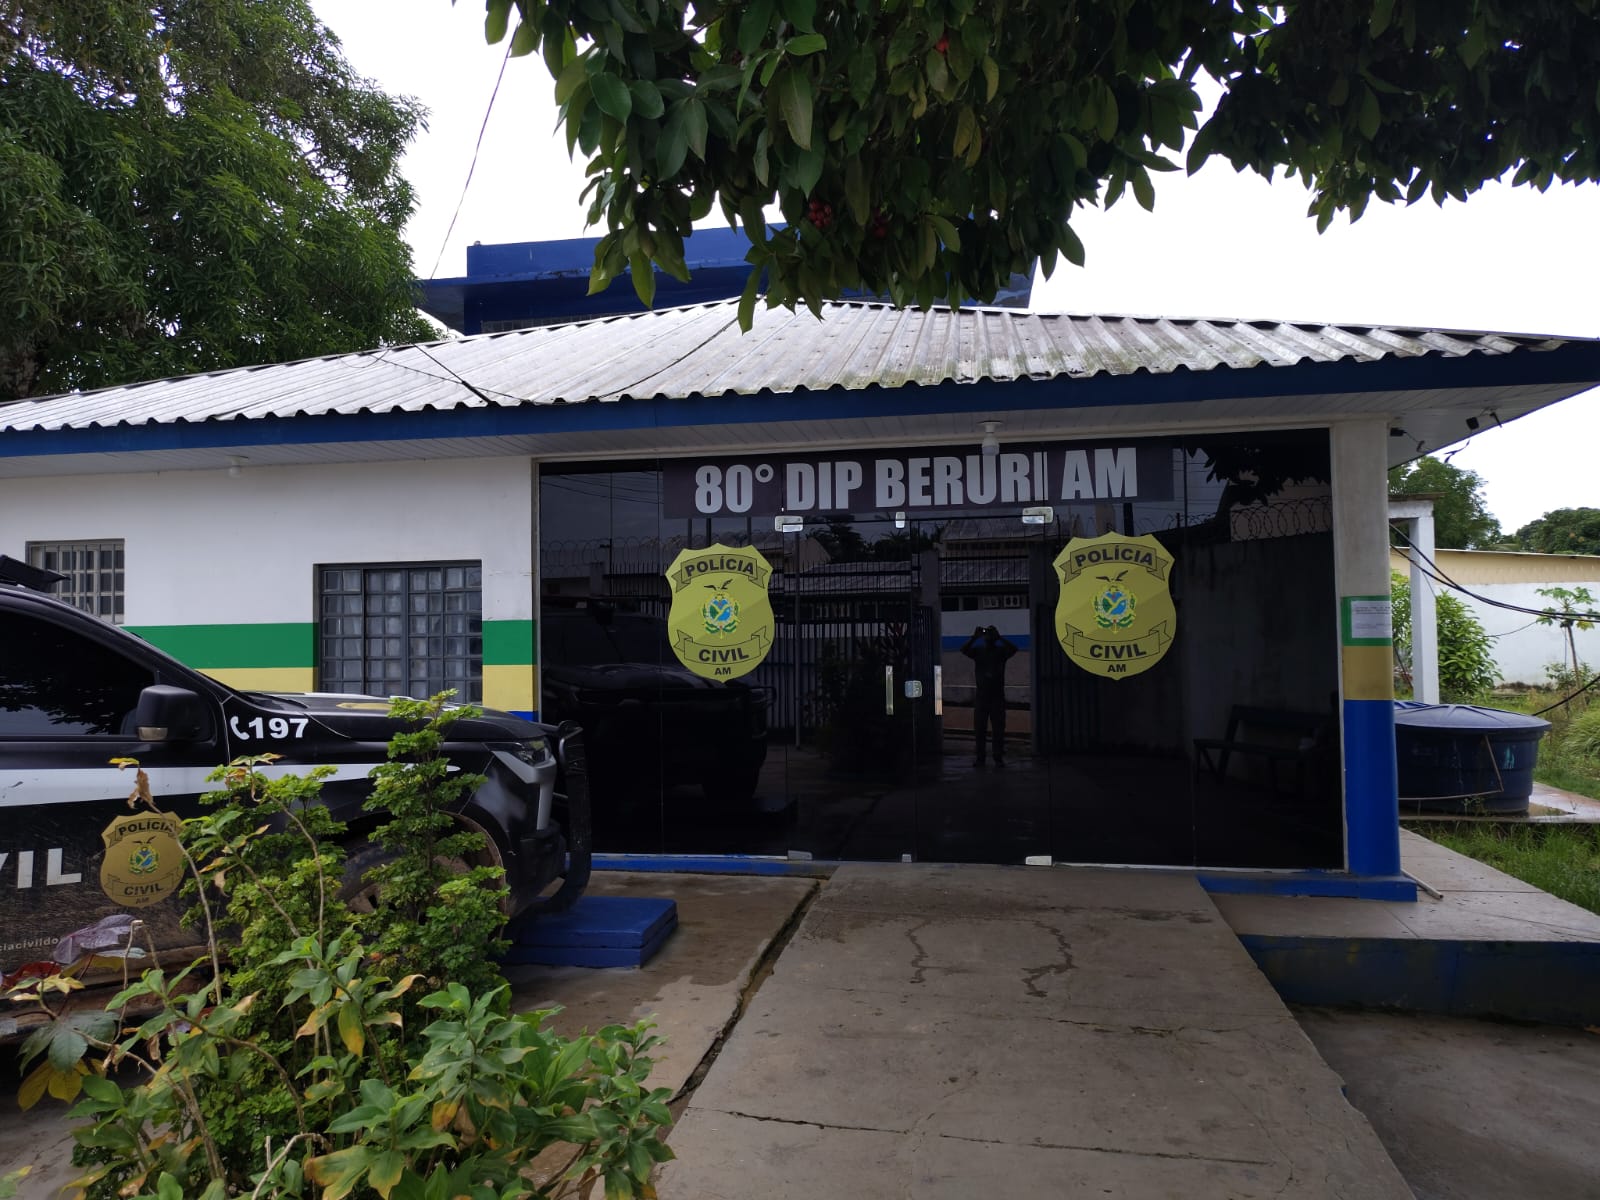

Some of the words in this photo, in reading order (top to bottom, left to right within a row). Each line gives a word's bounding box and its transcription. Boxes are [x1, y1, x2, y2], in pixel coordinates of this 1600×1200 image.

[786, 461, 863, 511] DIP
[875, 451, 1049, 508] BERURI
[1061, 447, 1138, 500] AM
[1075, 545, 1153, 567] POLÍCIA
[684, 556, 754, 577] POLÍCIA
[698, 647, 749, 662] CIVIL
[1089, 643, 1147, 659] CIVIL
[714, 667, 731, 675] AM
[1107, 664, 1126, 672] AM
[248, 716, 309, 739] 197
[124, 883, 164, 895] CIVIL
